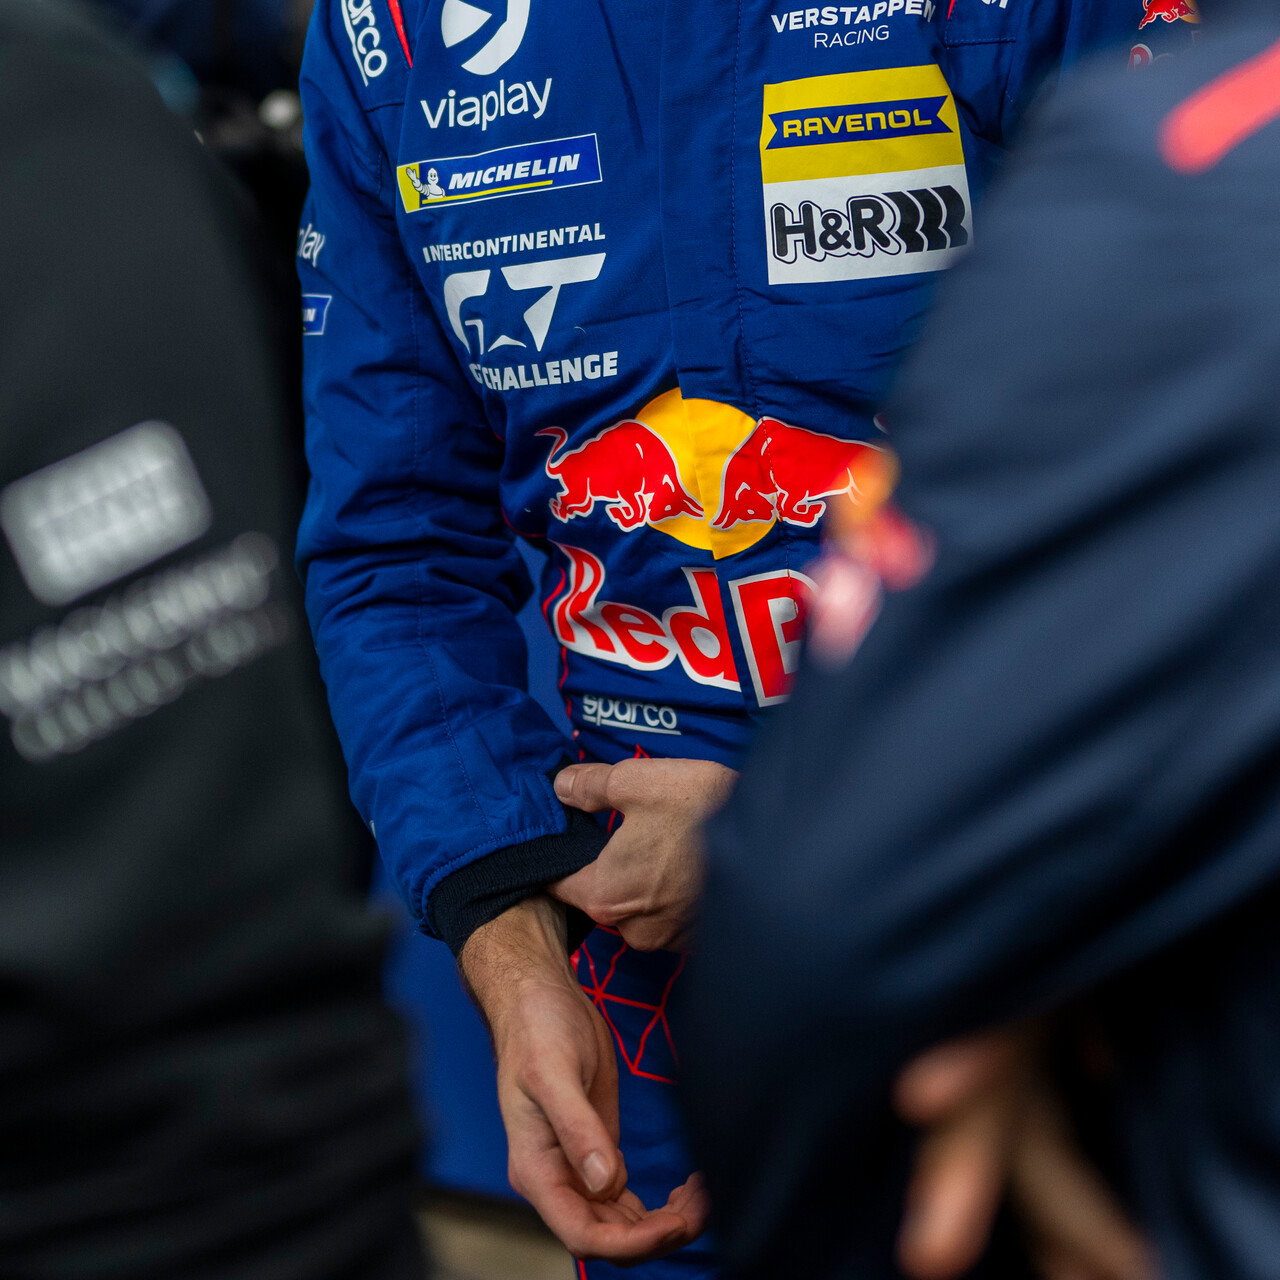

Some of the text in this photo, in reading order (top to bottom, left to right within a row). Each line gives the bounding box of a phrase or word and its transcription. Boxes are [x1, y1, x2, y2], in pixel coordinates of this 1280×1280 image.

[814, 25, 890, 48] RACING
[420, 78, 552, 131] viaplay
[783, 109, 932, 138] RAVENOL
[448, 153, 580, 190] MICHELIN
[422, 223, 606, 263] INTERCONTINENTAL
[771, 195, 902, 263] H&R
[481, 351, 618, 390] CHALLENGE
[550, 539, 742, 692] Red
[582, 695, 682, 735] sparco
